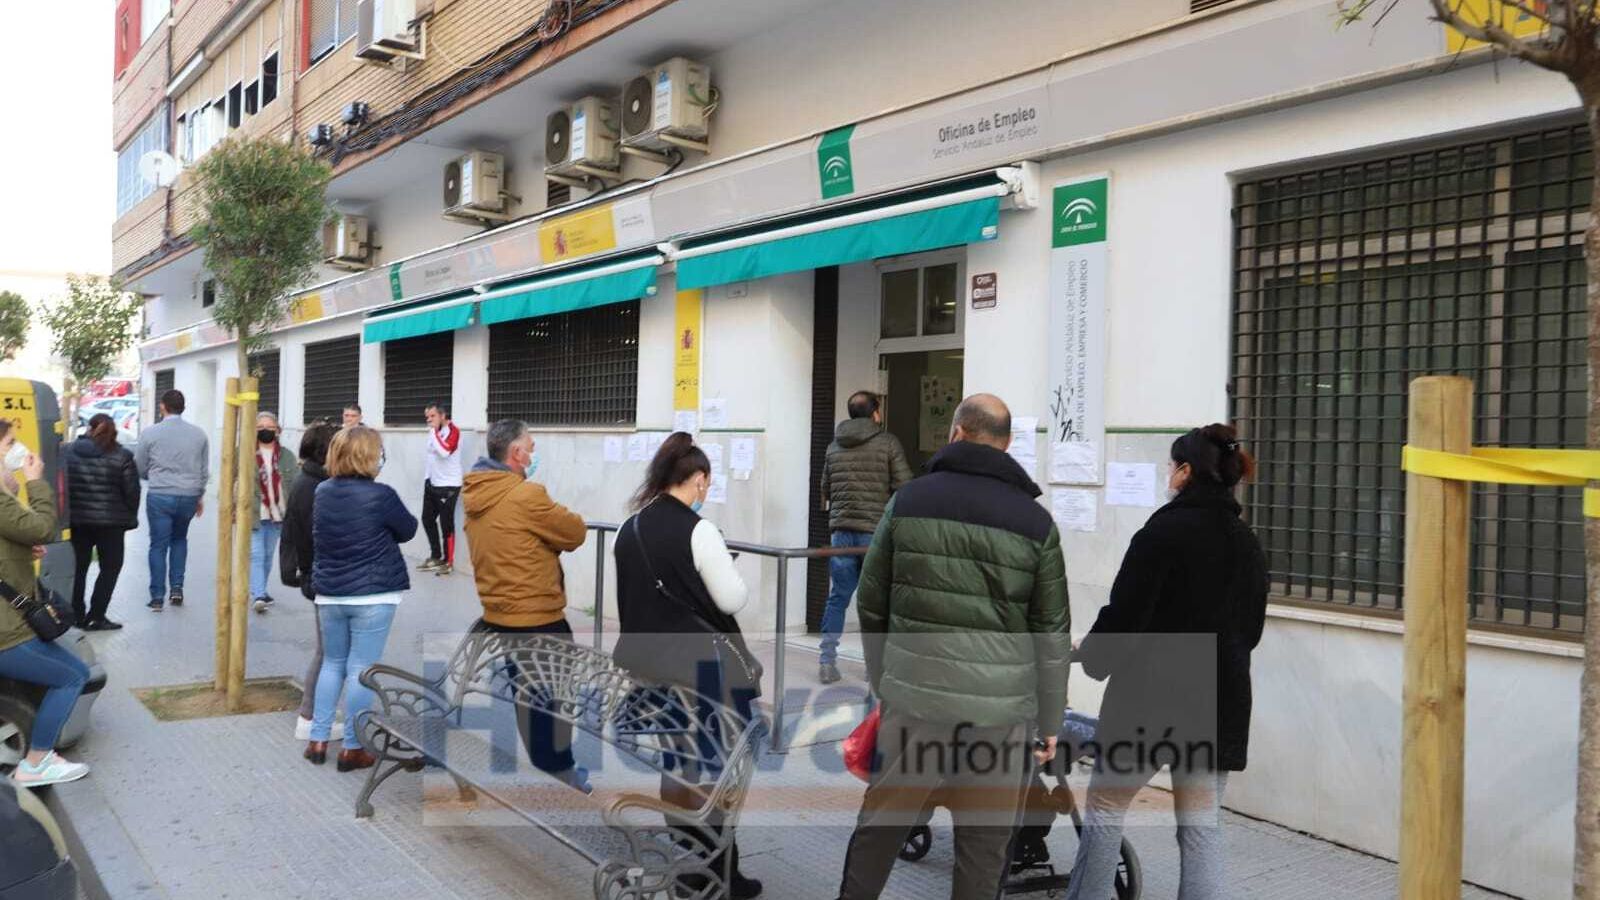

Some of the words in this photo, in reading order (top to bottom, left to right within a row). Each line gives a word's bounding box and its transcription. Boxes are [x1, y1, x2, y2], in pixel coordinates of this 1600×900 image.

[932, 145, 960, 159] Servicio
[961, 138, 993, 153] Andaluz
[995, 134, 1006, 143] de
[1007, 125, 1038, 141] Empleo
[939, 122, 975, 142] Oficina
[978, 117, 991, 132] de
[993, 107, 1036, 128] Empleo
[1065, 260, 1076, 297] Empleo
[1079, 259, 1088, 308] COMERCIO
[1065, 299, 1075, 311] de
[1078, 317, 1087, 357] EMPRESA
[4, 397, 32, 410] S.L.
